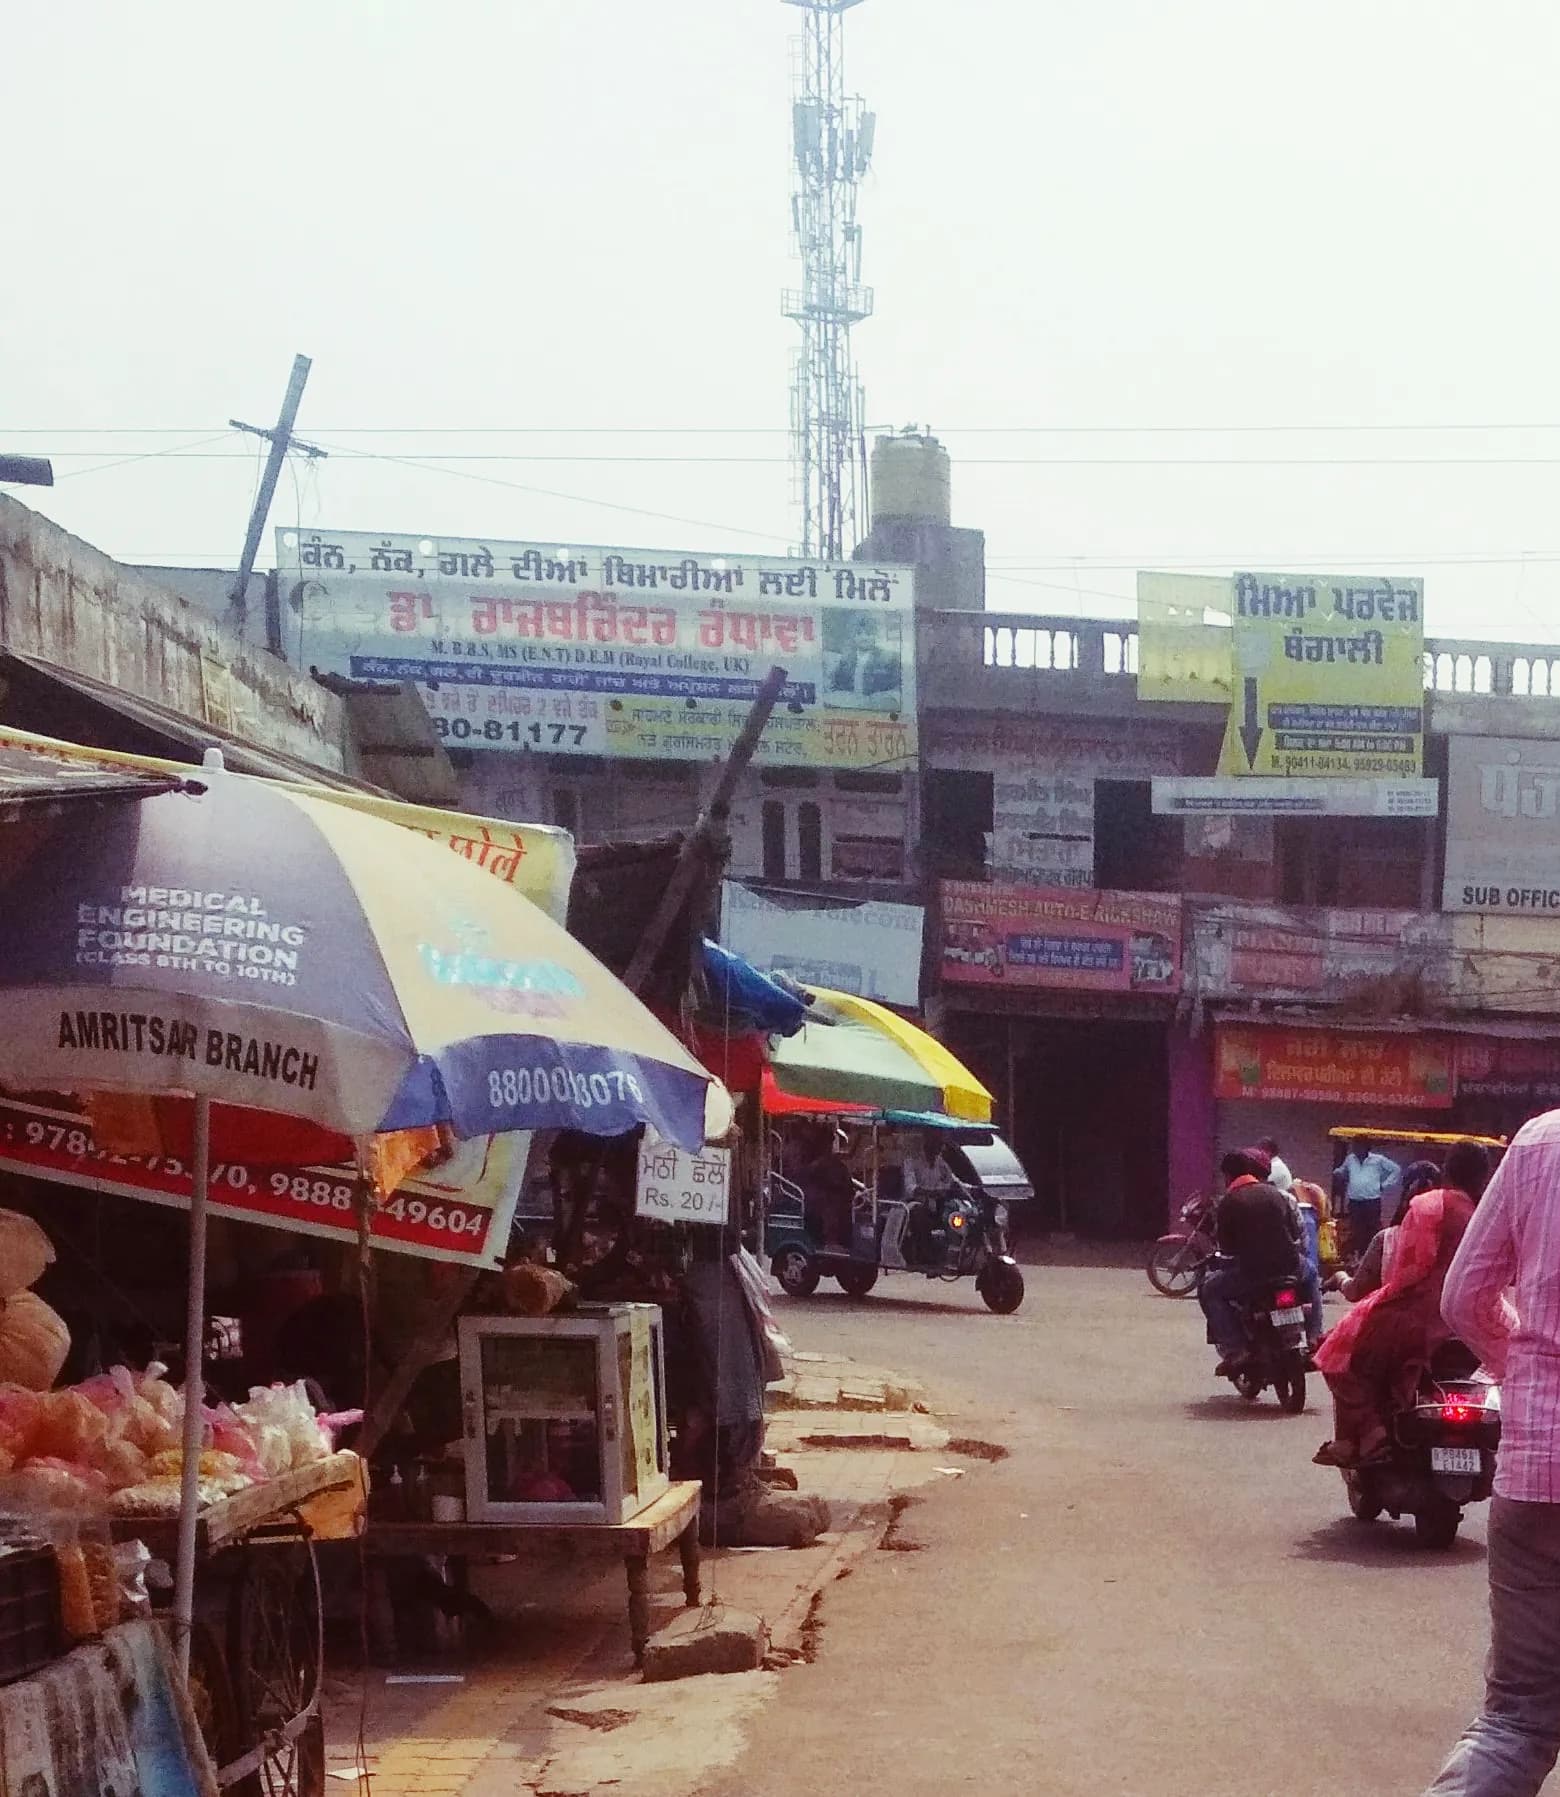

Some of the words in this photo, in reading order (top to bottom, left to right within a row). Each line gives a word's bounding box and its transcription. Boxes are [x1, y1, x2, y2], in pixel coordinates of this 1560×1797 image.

[438, 546, 495, 578] ਗਲੇ
[760, 567, 818, 597] ਲਈ
[1332, 577, 1418, 622] ਪਰਵੇਜ
[698, 597, 815, 653] ਰੰਧਾਵਾ
[619, 651, 661, 670] (Royal
[667, 655, 718, 674] College,
[1284, 627, 1383, 665] ਬੰਗਾਲੀ
[122, 886, 268, 918] MEDICAL
[1462, 886, 1501, 907] SUB
[78, 903, 307, 948] ENGINEERING
[76, 951, 150, 967] (CLASS
[157, 955, 198, 972] 8TH
[205, 959, 231, 978] TO
[238, 963, 297, 987] 10TH)
[78, 928, 299, 972] FOUNDATION
[58, 1010, 198, 1061] AMRITSAR
[205, 1029, 319, 1091] BRANCH
[645, 1187, 674, 1208] Rs.
